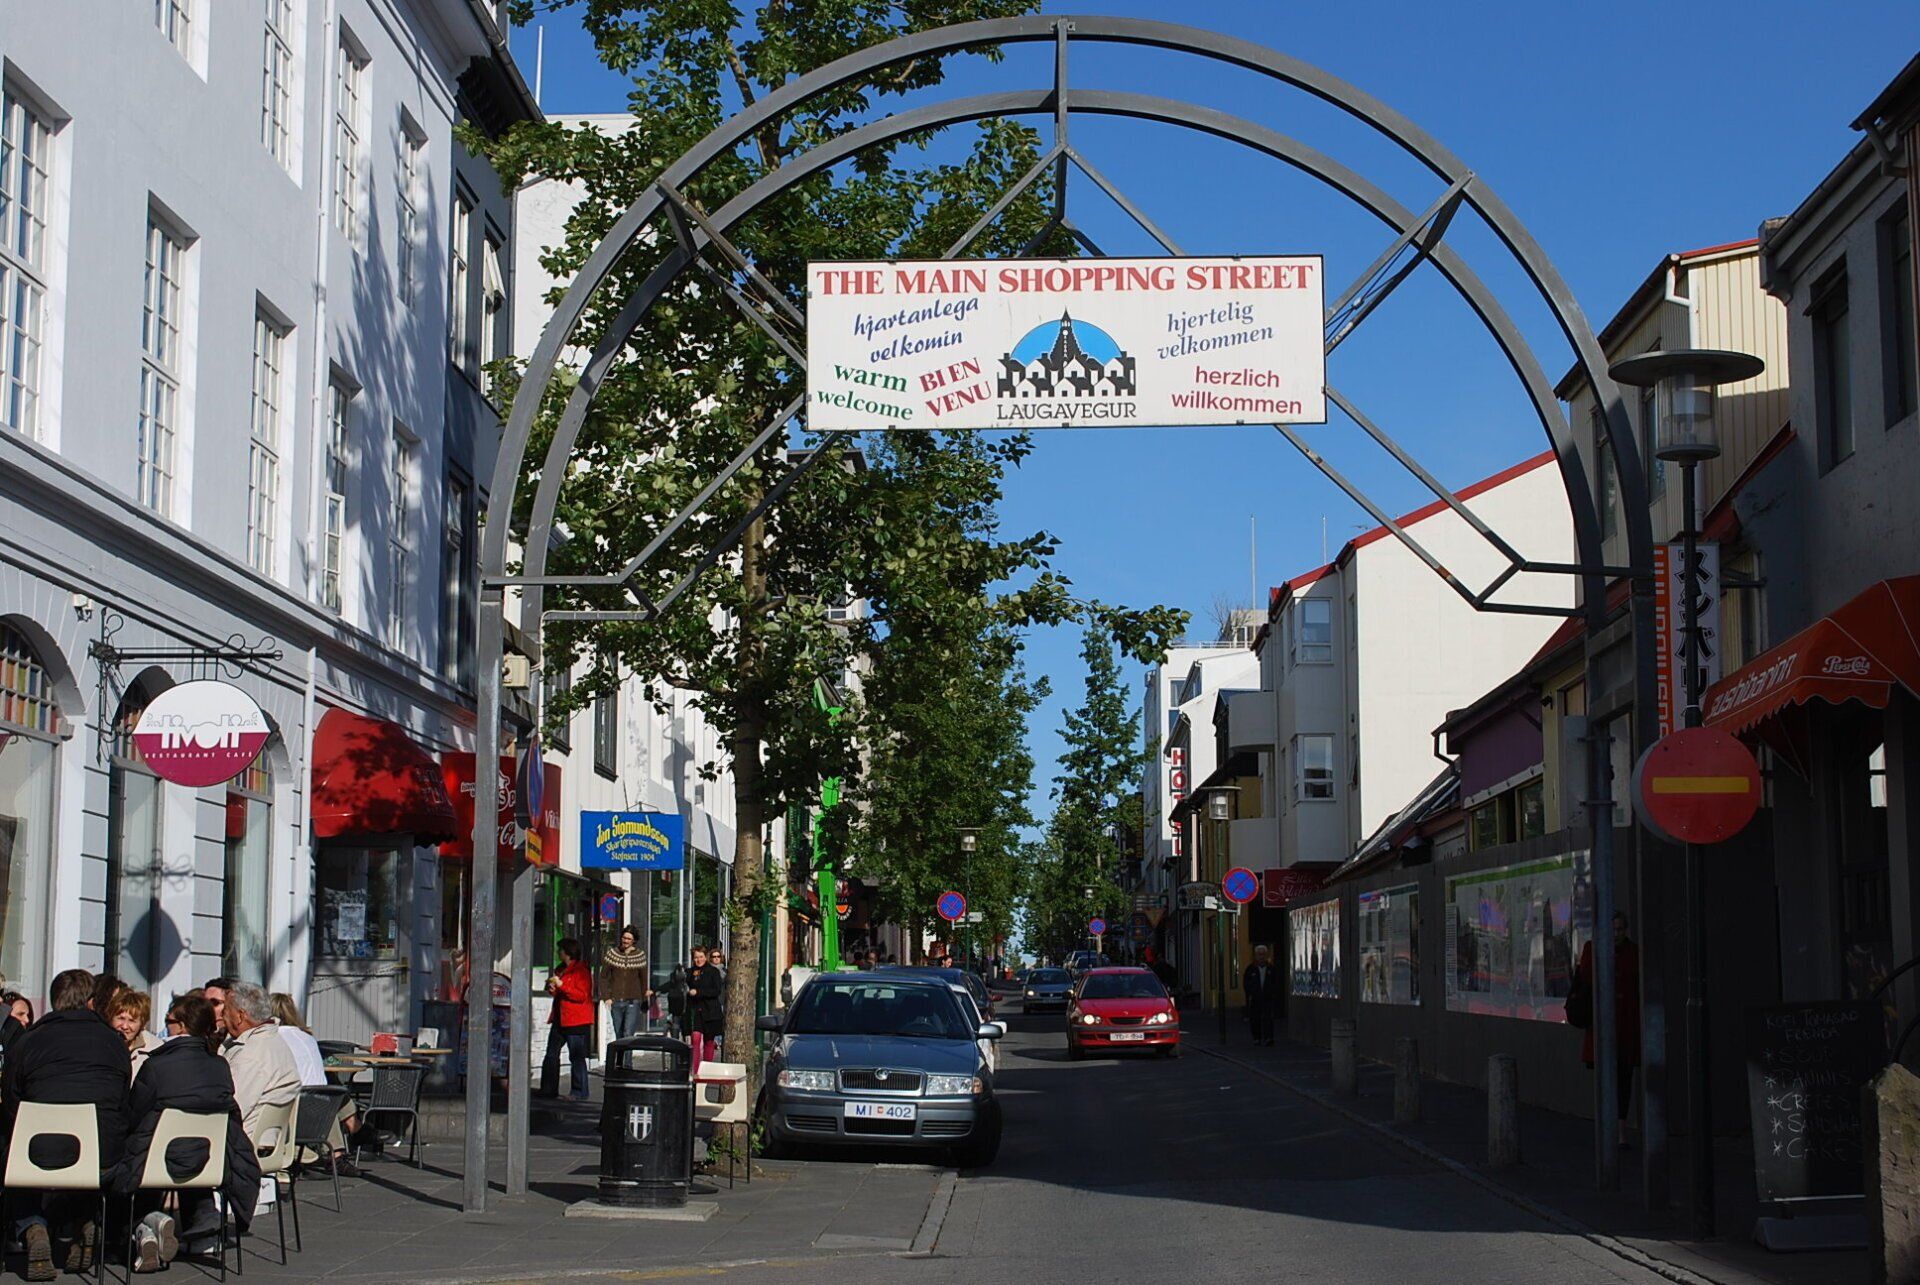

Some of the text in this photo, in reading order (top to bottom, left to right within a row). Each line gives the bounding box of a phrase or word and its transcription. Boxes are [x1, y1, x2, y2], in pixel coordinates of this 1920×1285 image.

[817, 265, 1313, 295] THE MAIN SHOPPING STREET
[854, 297, 979, 341] hjartanlega
[1167, 301, 1254, 337] hjertelig
[870, 330, 963, 363] velkomin
[1157, 327, 1273, 359] velkommen
[834, 364, 907, 392] warm
[1196, 366, 1279, 388] herzlich
[817, 390, 913, 421] welcome
[925, 381, 992, 417] VENU
[997, 402, 1137, 420] LAUGAVEGUR
[1172, 391, 1302, 414] willkommen
[887, 1106, 911, 1118] 402
